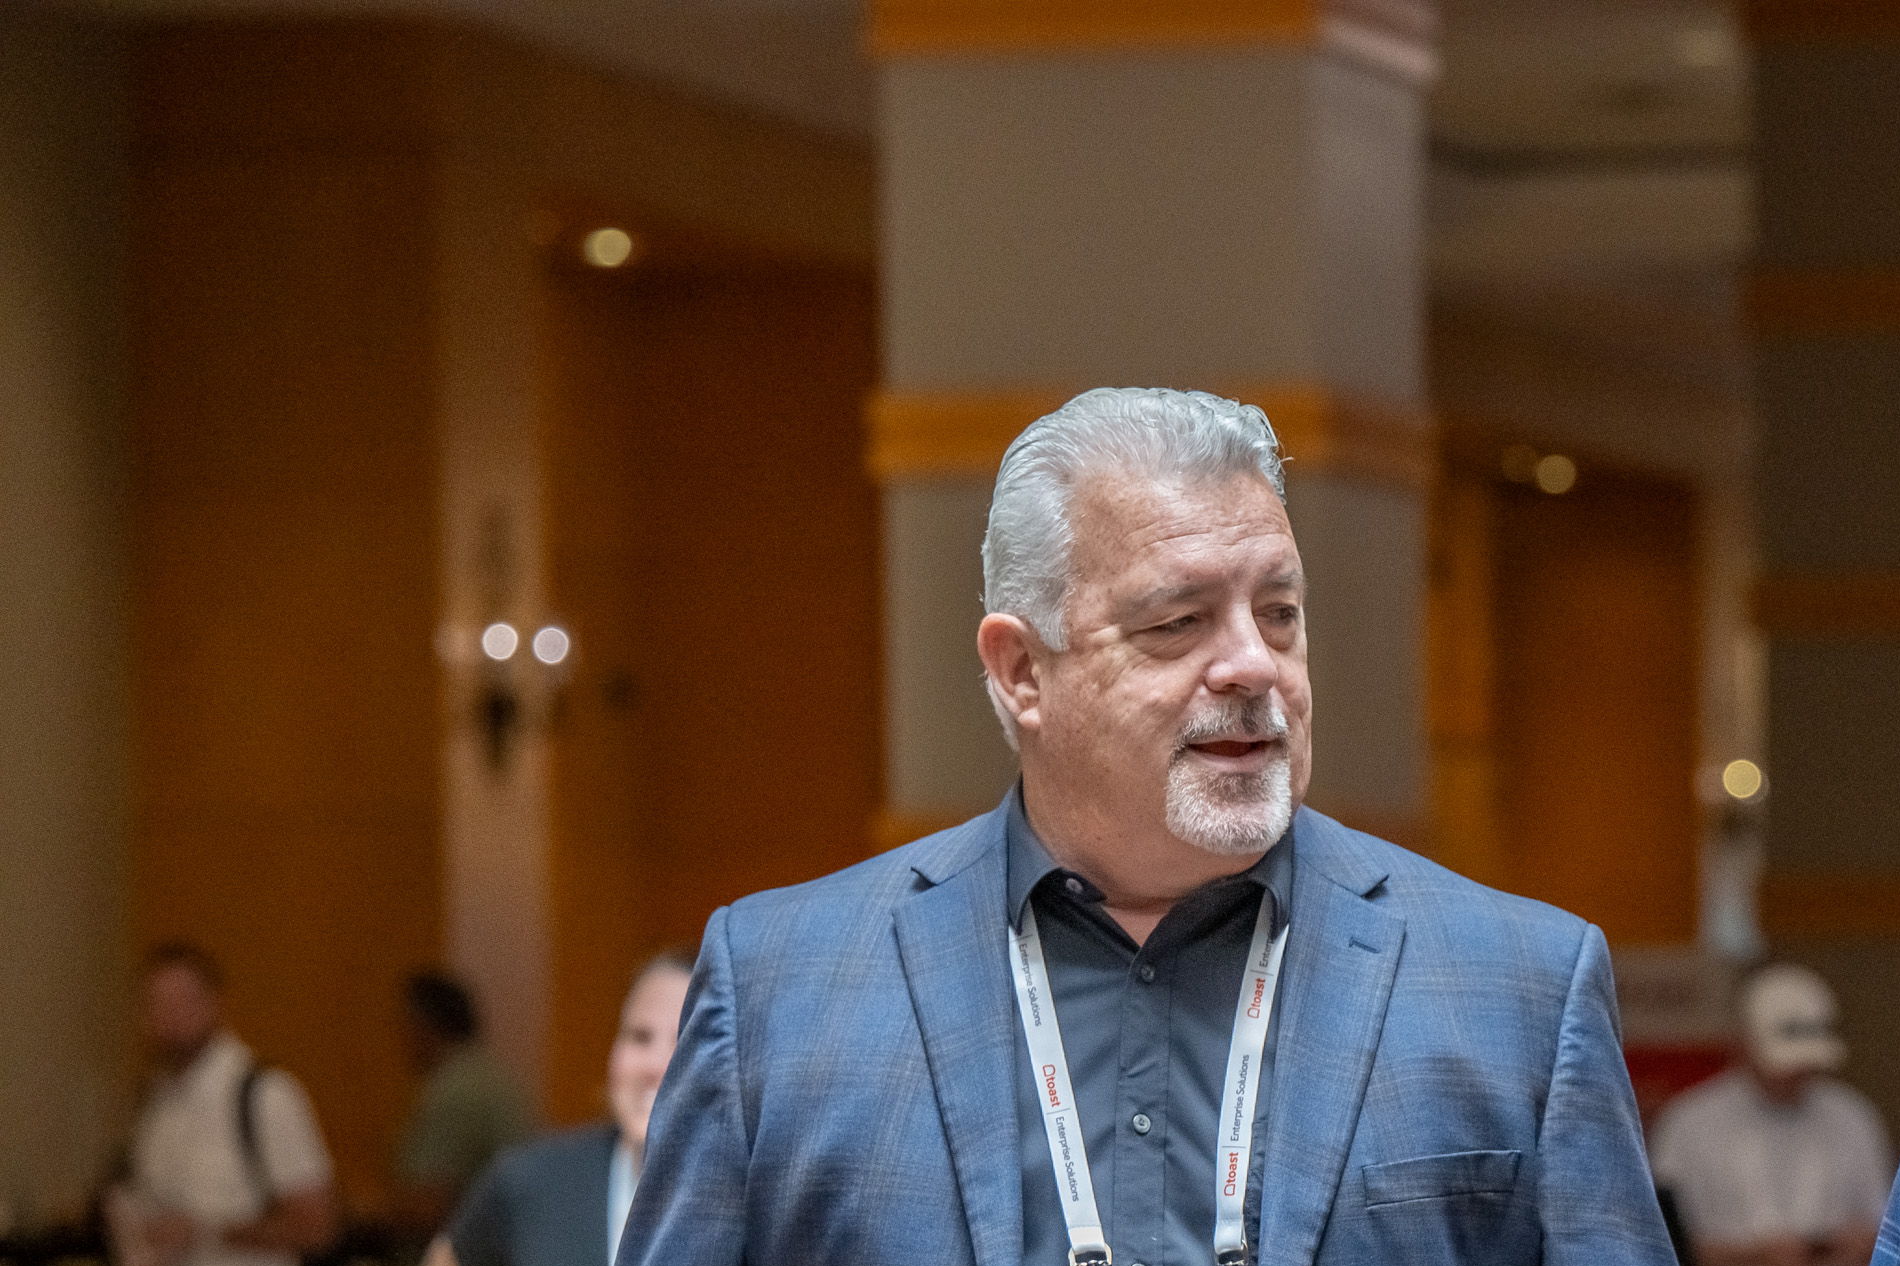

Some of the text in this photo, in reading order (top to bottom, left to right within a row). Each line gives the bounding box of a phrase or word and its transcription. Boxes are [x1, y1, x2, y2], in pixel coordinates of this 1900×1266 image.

[1019, 943, 1041, 1027] Enterprise Solutions
[1251, 977, 1266, 1008] toast
[1046, 1076, 1079, 1202] toast Enterprise Solutions
[1227, 1054, 1249, 1183] toast Enterprise Solutions
